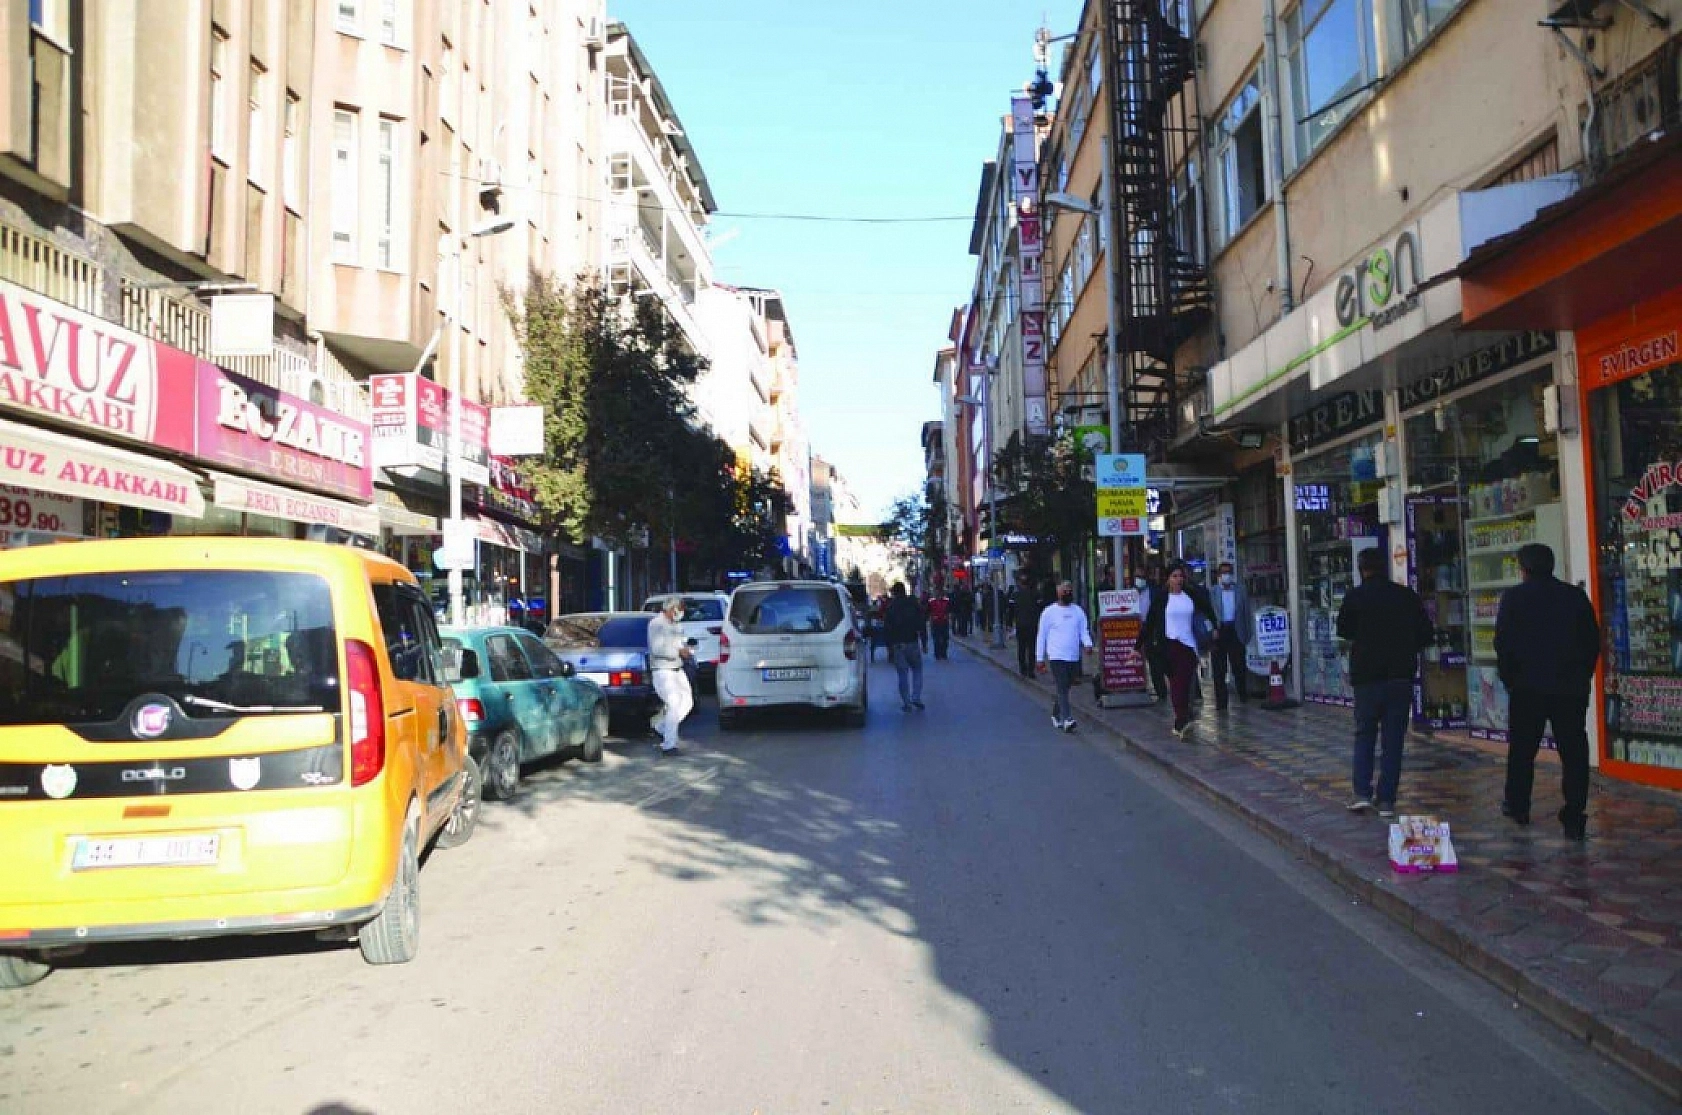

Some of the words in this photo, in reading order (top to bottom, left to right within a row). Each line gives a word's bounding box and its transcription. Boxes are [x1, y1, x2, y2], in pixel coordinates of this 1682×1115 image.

[1600, 332, 1678, 381] EVİRGEN
[0, 371, 135, 434] AKKABI
[0, 445, 47, 475] UZ
[59, 460, 188, 504] AYAKKABI
